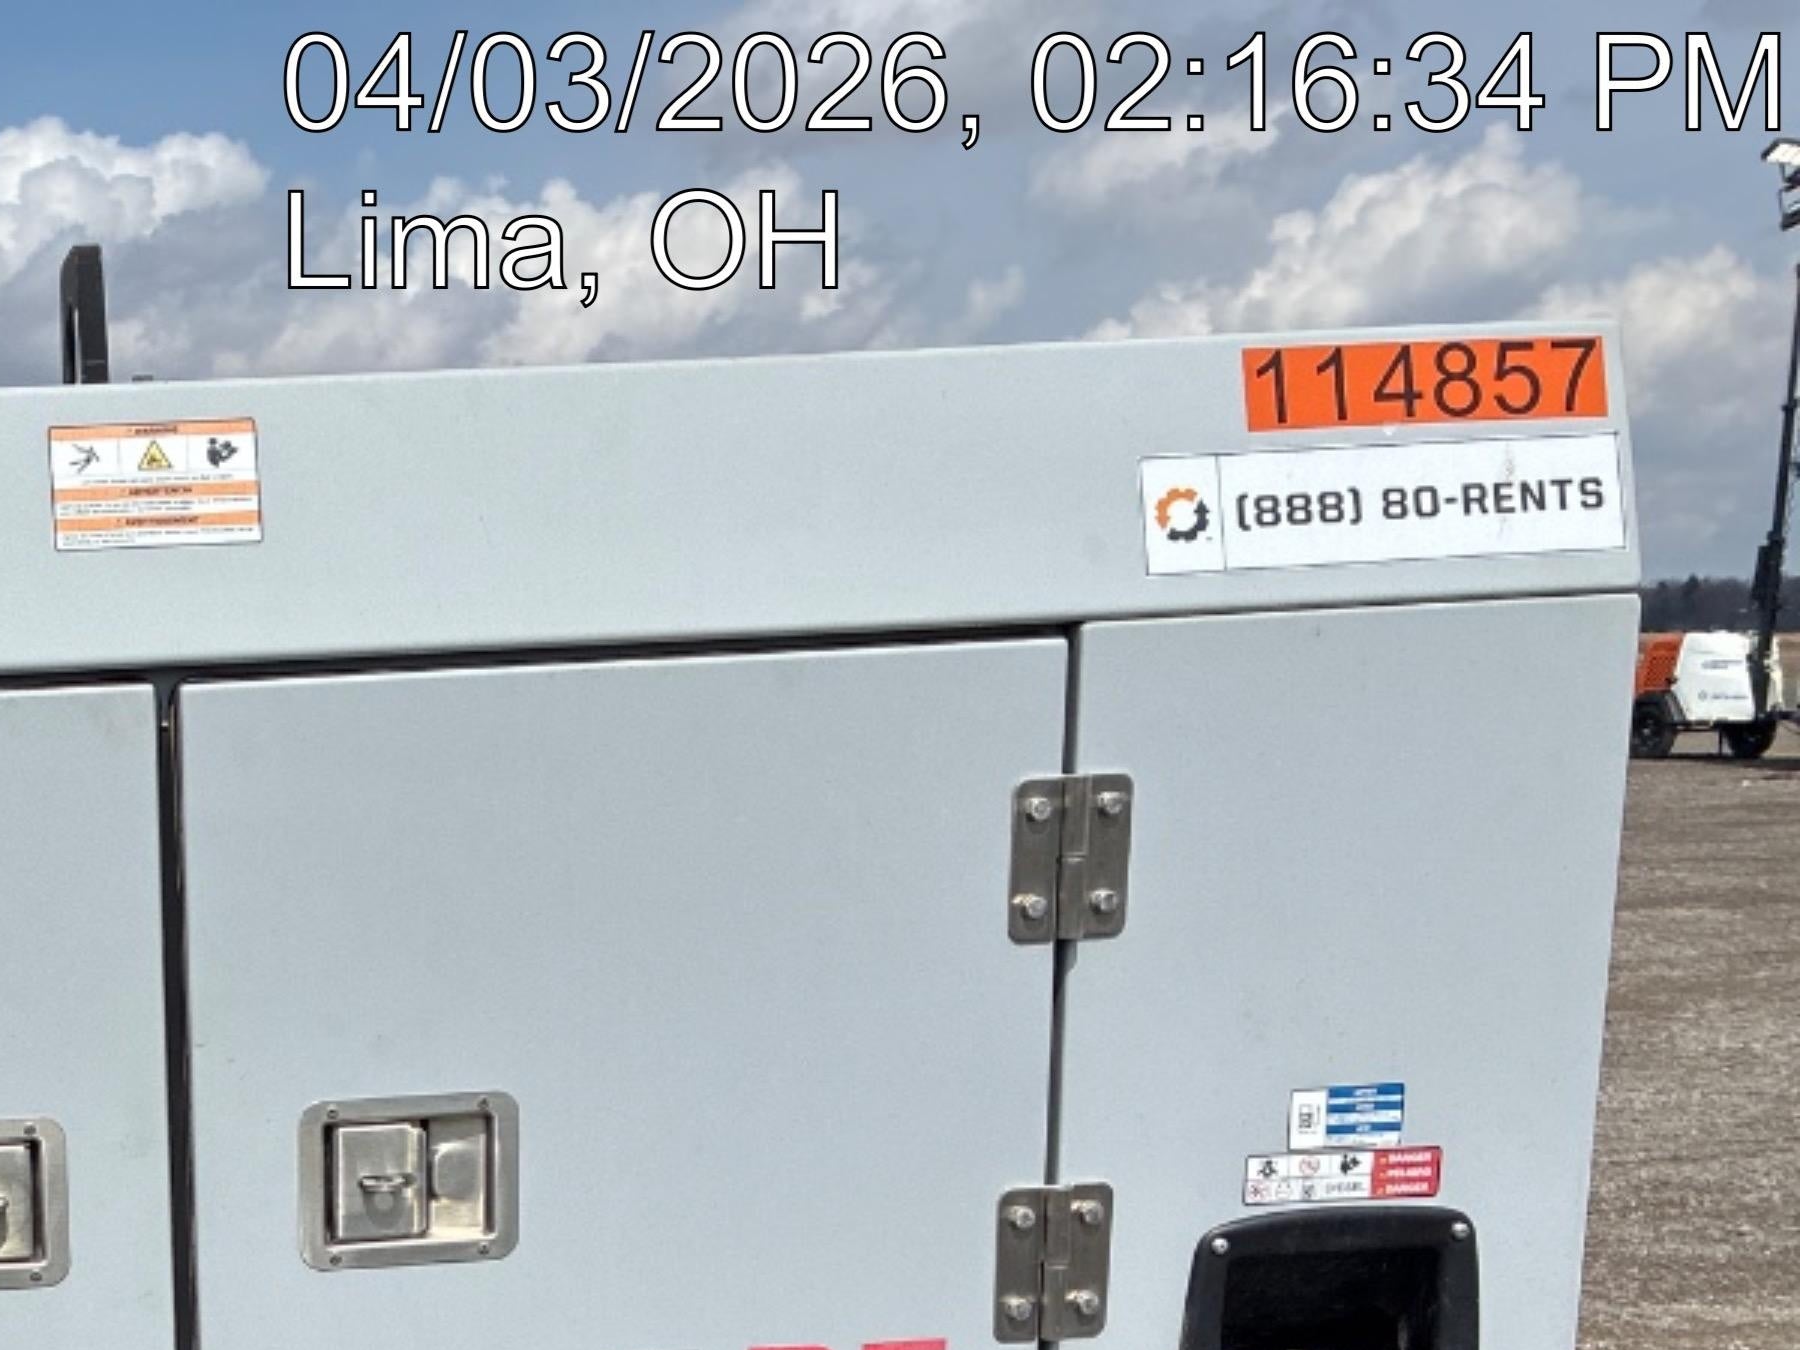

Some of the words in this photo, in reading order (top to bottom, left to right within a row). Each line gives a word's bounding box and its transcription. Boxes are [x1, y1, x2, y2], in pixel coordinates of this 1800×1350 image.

[1256, 338, 1597, 425] 114857
[1236, 487, 1362, 531] (888)
[1382, 477, 1604, 520] 80-RENTS
